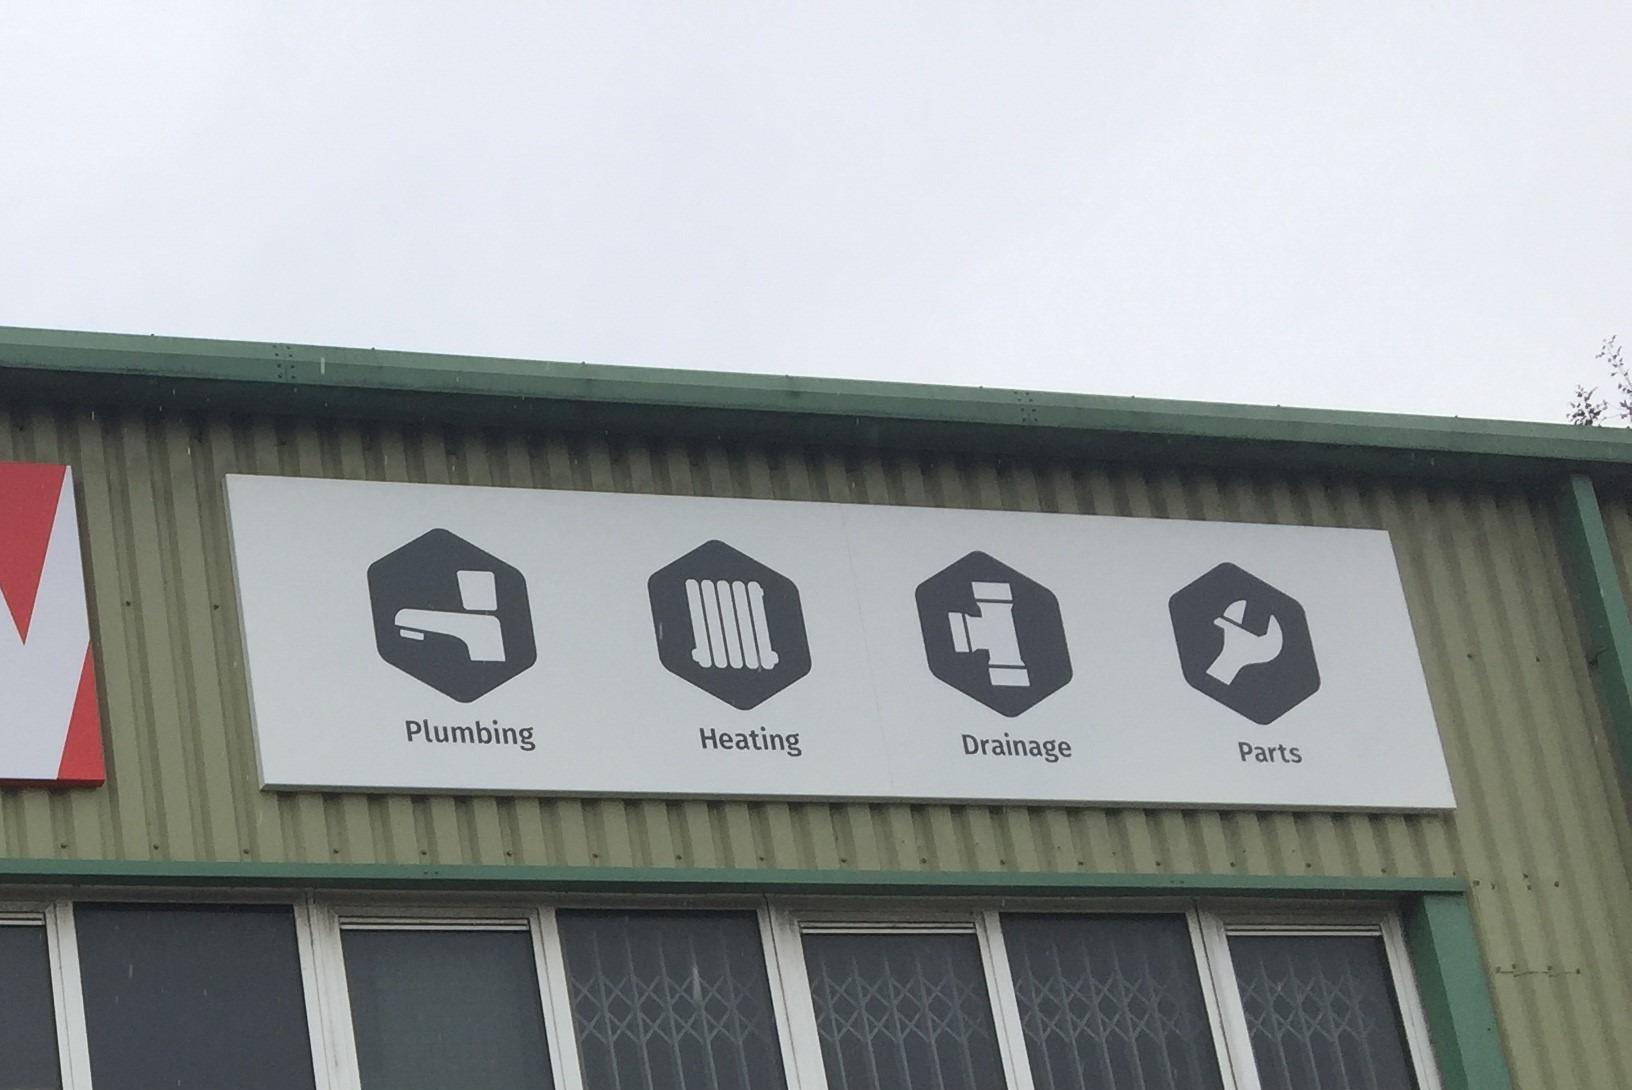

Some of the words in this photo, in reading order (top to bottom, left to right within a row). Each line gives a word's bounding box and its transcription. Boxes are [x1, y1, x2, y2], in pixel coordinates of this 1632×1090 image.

[404, 719, 537, 752] Plumbing
[698, 726, 803, 757] Heating
[961, 733, 1073, 763] Drainage
[1238, 741, 1304, 764] Parts
